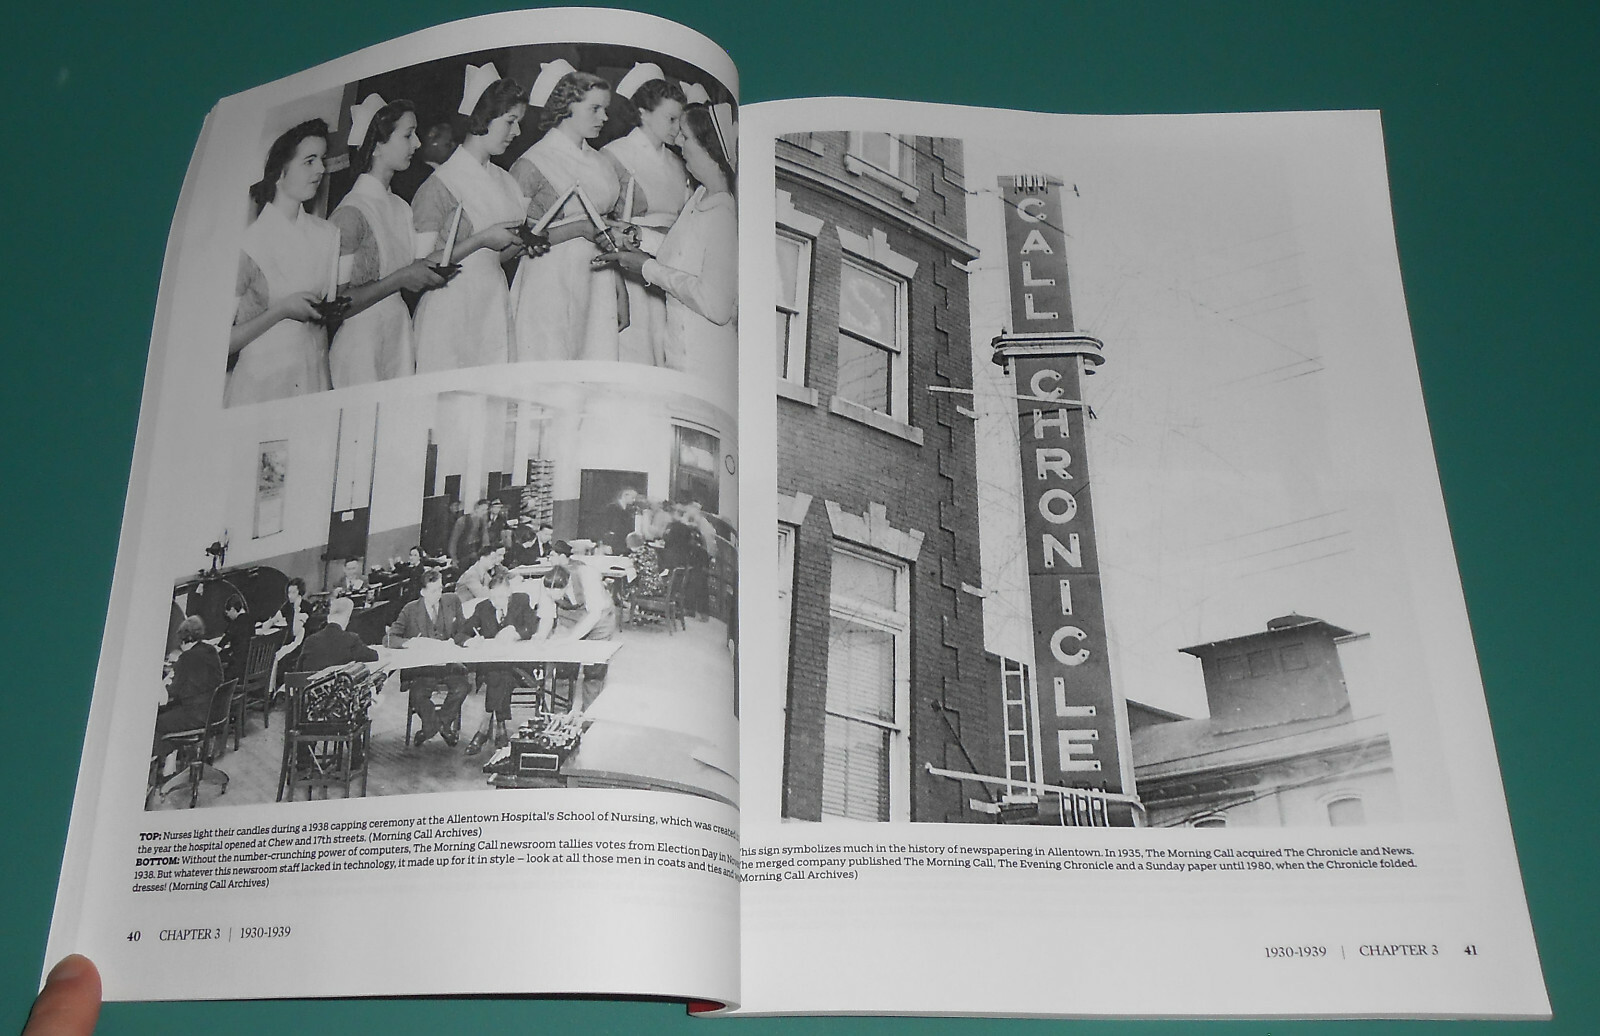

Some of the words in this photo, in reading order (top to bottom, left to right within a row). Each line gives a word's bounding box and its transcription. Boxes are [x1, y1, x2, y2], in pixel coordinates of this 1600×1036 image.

[1016, 197, 1059, 320] CALL
[1030, 368, 1102, 773] CHRONICLE
[138, 831, 162, 842] TOP:
[162, 830, 192, 841] Nurses
[192, 828, 214, 840] light
[214, 827, 235, 838] their
[235, 825, 270, 836] candles
[270, 823, 301, 835] during
[301, 824, 308, 833] a
[308, 821, 329, 832] 1938
[329, 820, 368, 832] capping
[368, 818, 416, 829] ceremony
[415, 816, 427, 826] at
[427, 814, 445, 825] the
[445, 813, 500, 824] Allentown
[500, 811, 555, 823] Hospital's
[556, 810, 596, 821] School
[596, 811, 609, 822] of
[610, 811, 658, 826] Nursing,
[659, 815, 693, 828] which
[693, 820, 712, 831] was
[137, 844, 153, 854] the
[152, 845, 172, 855] year
[172, 842, 188, 853] the
[187, 839, 223, 853] hospital
[223, 838, 257, 851] opened
[256, 838, 267, 848] at
[267, 837, 294, 848] Chew
[294, 835, 312, 846] and
[312, 834, 332, 845] 17th
[332, 833, 367, 844] streets.
[368, 830, 412, 844] (Morning
[413, 828, 433, 840] Call
[433, 826, 483, 839] Archives)
[740, 847, 757, 856] his
[757, 845, 780, 857] sign
[781, 843, 842, 856] symbolizes
[842, 843, 874, 853] much
[875, 843, 887, 853] in
[888, 843, 906, 853] the
[907, 843, 946, 855] history
[946, 844, 959, 854] of
[959, 846, 1034, 858] newspapering
[1034, 846, 1045, 856] in
[1047, 846, 1104, 857] Allentown.
[1104, 848, 1116, 858] In
[1117, 848, 1144, 859] 1935,
[1144, 848, 1166, 858] The
[1166, 848, 1212, 860] Morning
[1213, 848, 1235, 858] Call
[1235, 848, 1283, 859] acquired
[1283, 847, 1305, 857] The
[1305, 846, 1358, 857] Chronicle
[1359, 846, 1381, 856] and
[1381, 846, 1414, 856] News.
[135, 856, 180, 867] BOTTOM:
[181, 854, 217, 865] Without
[217, 853, 232, 863] the
[232, 849, 317, 862] number-crunching
[317, 849, 347, 860] power
[347, 845, 358, 857] of
[358, 845, 411, 857] computers,
[412, 842, 432, 853] The
[432, 841, 476, 853] Morning
[477, 839, 498, 851] Call
[499, 840, 557, 850] newsroom
[558, 838, 593, 849] tallies
[595, 839, 626, 850] votes
[627, 839, 655, 852] from
[656, 841, 700, 857] Election
[701, 847, 718, 861] Day
[718, 851, 726, 862] in
[133, 870, 156, 880] 1938.
[156, 869, 173, 879] But
[173, 868, 214, 878] whatever
[214, 866, 232, 876] this
[231, 865, 278, 875] newsroom
[278, 862, 301, 873] staff
[300, 861, 331, 872] lacked
[331, 861, 342, 871] in
[343, 858, 397, 871] technology,
[397, 858, 406, 868] it
[406, 856, 435, 867] made
[436, 857, 450, 867] up
[450, 854, 466, 865] for
[466, 854, 476, 865] it
[476, 854, 488, 865] in
[488, 853, 515, 866] style
[526, 852, 551, 863] look
[551, 853, 564, 863] at
[565, 852, 580, 863] all
[581, 852, 614, 864] those
[615, 855, 642, 865] men
[643, 855, 655, 866] in
[656, 858, 686, 869] coats
[686, 861, 706, 872] and
[706, 862, 722, 875] ties
[740, 859, 754, 870] he
[755, 857, 795, 869] merged
[796, 858, 847, 868] company
[848, 856, 902, 868] published
[903, 856, 925, 866] The
[925, 857, 971, 869] Morning
[972, 857, 996, 869] Call,
[997, 858, 1018, 868] The
[1019, 859, 1062, 871] Evening
[1063, 859, 1114, 870] Chronicle
[1115, 860, 1136, 871] and
[1137, 863, 1144, 871] a
[1145, 860, 1186, 872] Sunday
[1186, 863, 1217, 872] paper
[1218, 860, 1245, 871] until
[1246, 860, 1274, 871] 1980,
[1275, 860, 1305, 870] when
[1306, 859, 1325, 870] the
[1325, 858, 1378, 869] Chronicle
[1379, 858, 1418, 868] folded.
[783, 870, 805, 880] Call
[806, 869, 859, 881] Archives)
[131, 882, 167, 893] dresses!
[168, 880, 209, 893] (Morning
[209, 878, 227, 890] Call
[227, 877, 270, 889] Archives)
[126, 930, 141, 942] 40
[158, 928, 212, 941] CHAPTER
[213, 927, 221, 940] 3
[240, 925, 291, 939] 1930-1939
[1265, 945, 1327, 958] 1930-1939
[1358, 944, 1428, 957] CHAPTER
[1431, 944, 1439, 956] 3
[1463, 944, 1477, 956] 41
